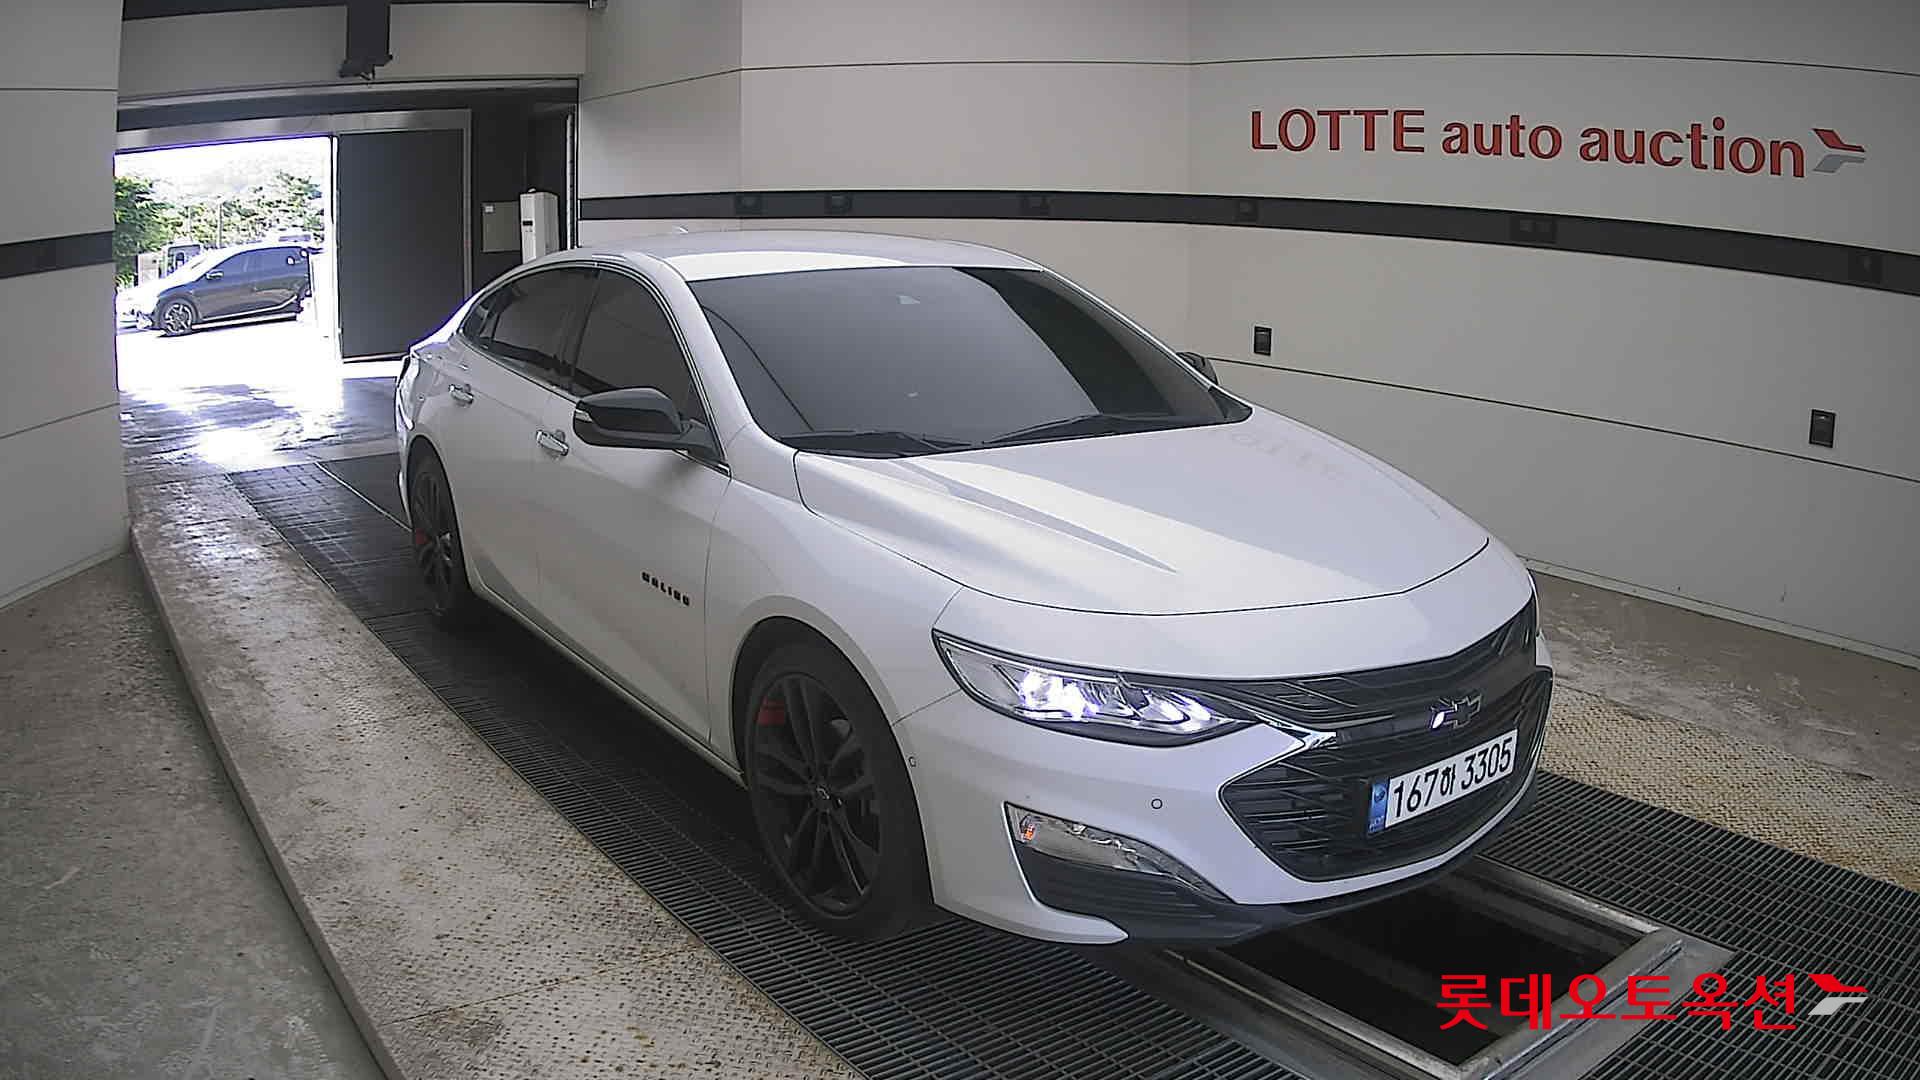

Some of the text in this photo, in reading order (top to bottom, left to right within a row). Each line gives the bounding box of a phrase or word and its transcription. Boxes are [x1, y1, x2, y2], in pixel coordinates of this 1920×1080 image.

[1251, 109, 1806, 178] LOTTE auto auction
[1461, 737, 1513, 790] 3305
